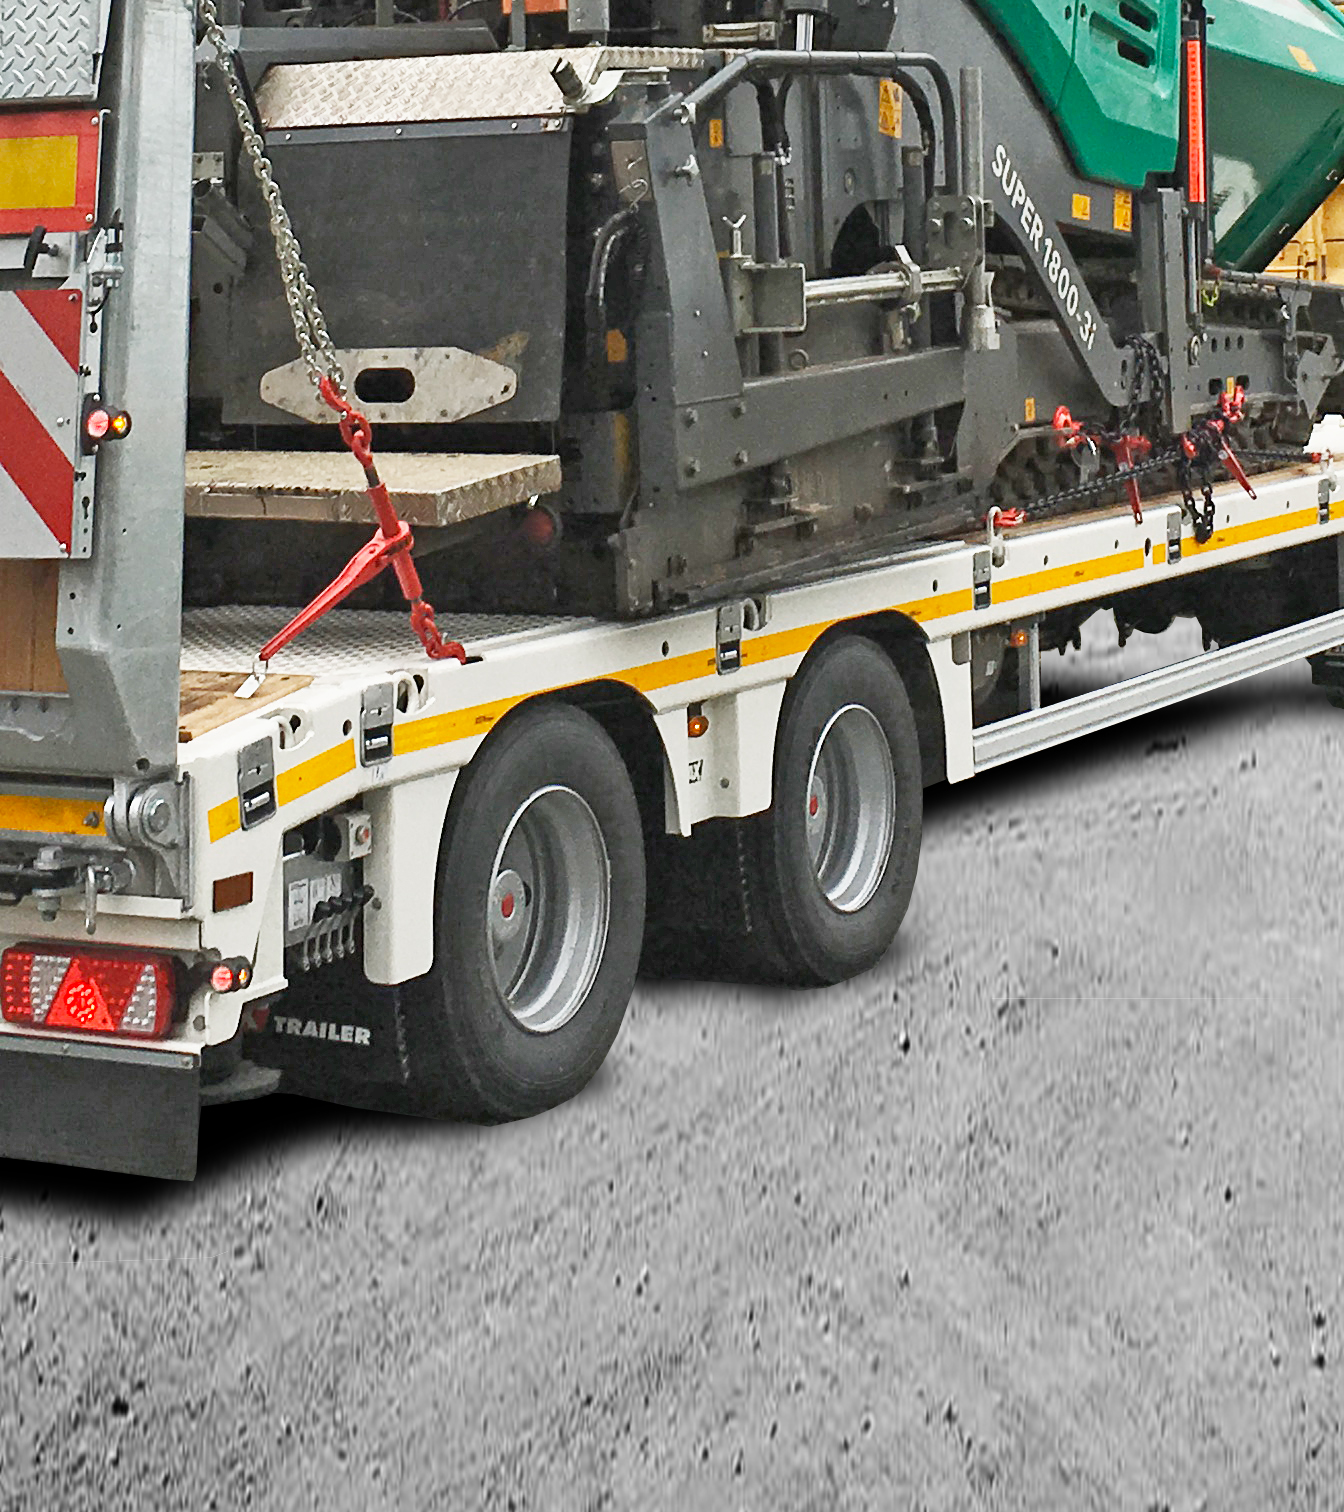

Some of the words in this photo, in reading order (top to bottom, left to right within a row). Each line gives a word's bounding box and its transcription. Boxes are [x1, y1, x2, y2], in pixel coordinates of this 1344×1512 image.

[991, 144, 1044, 252] SUPER
[1043, 237, 1097, 351] 1800-3i
[273, 1015, 371, 1046] TRAILER
